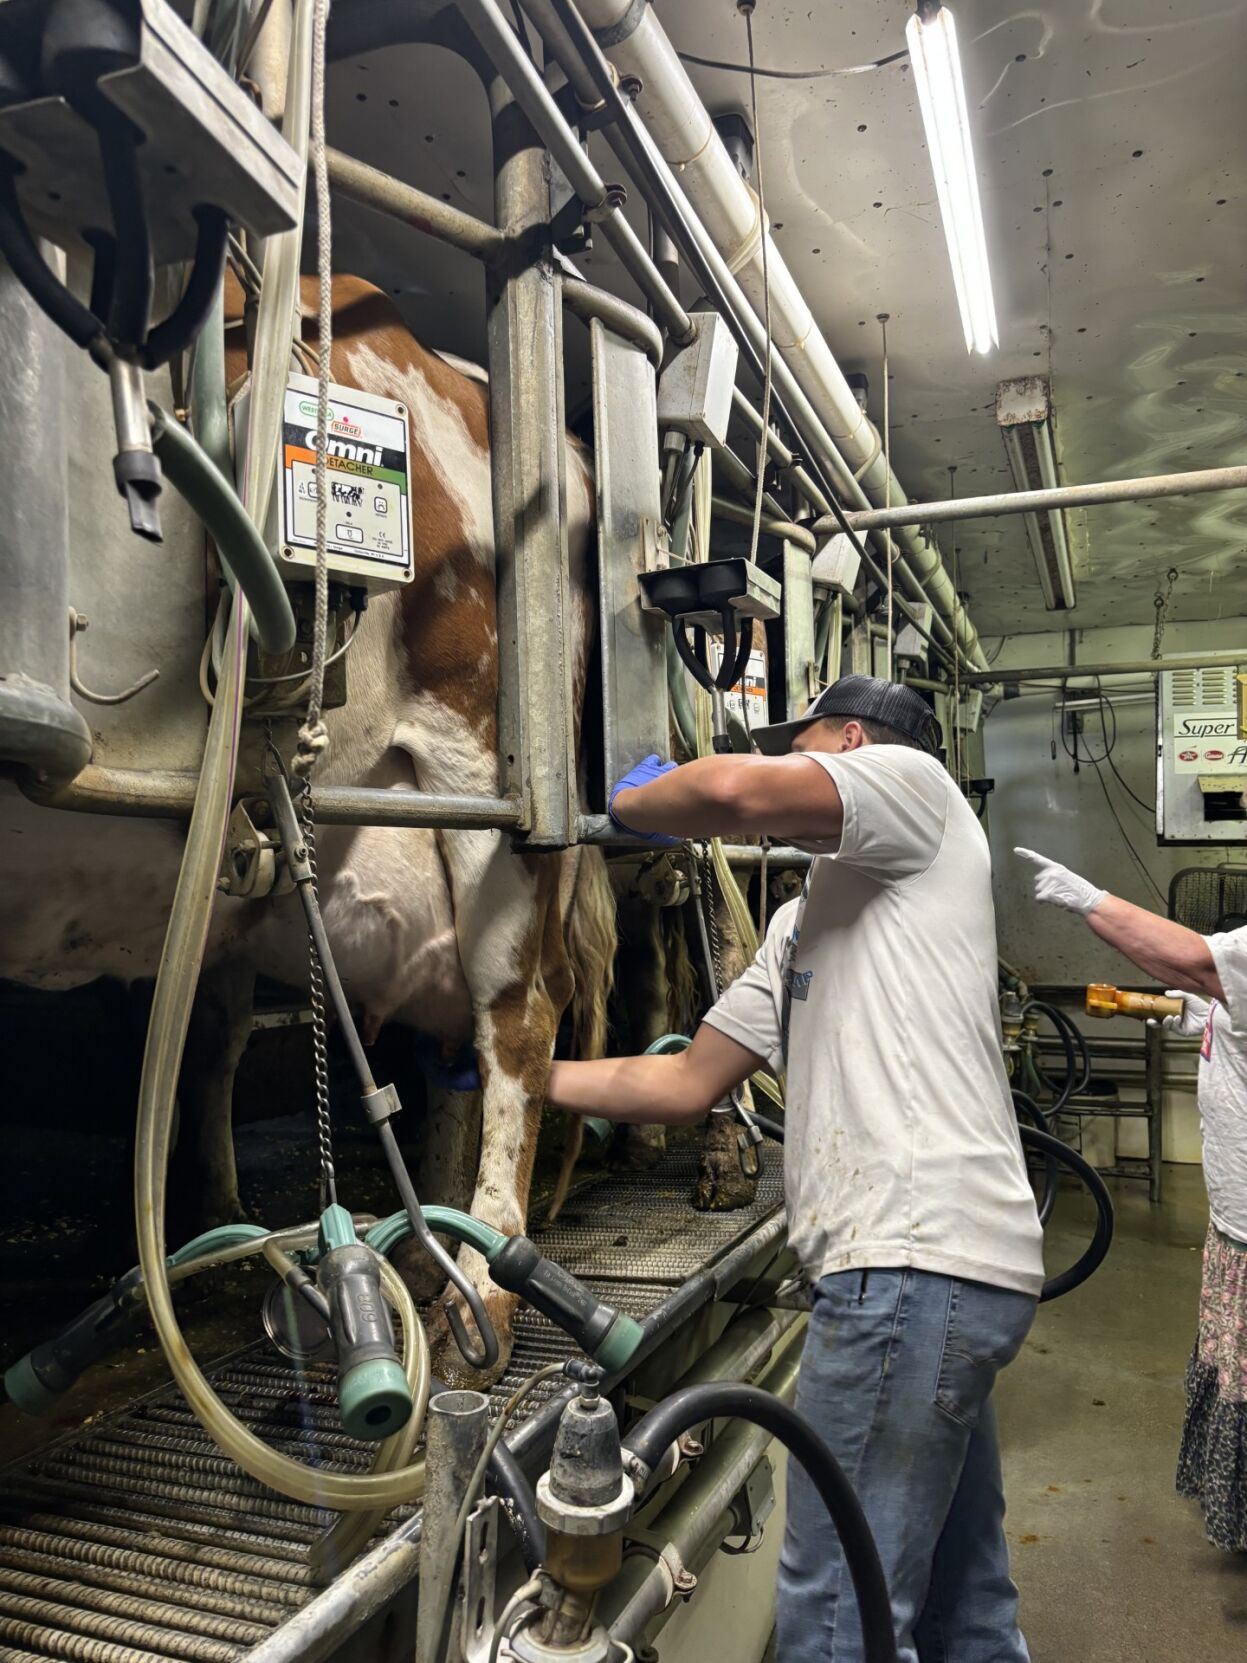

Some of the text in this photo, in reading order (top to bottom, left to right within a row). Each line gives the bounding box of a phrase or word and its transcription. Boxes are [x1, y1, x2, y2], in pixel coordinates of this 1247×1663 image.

[301, 405, 332, 417] WESTA
[334, 423, 358, 435] SURGE
[305, 430, 383, 467] Omni
[325, 457, 374, 475] ETACHER
[1178, 718, 1235, 738] Super
